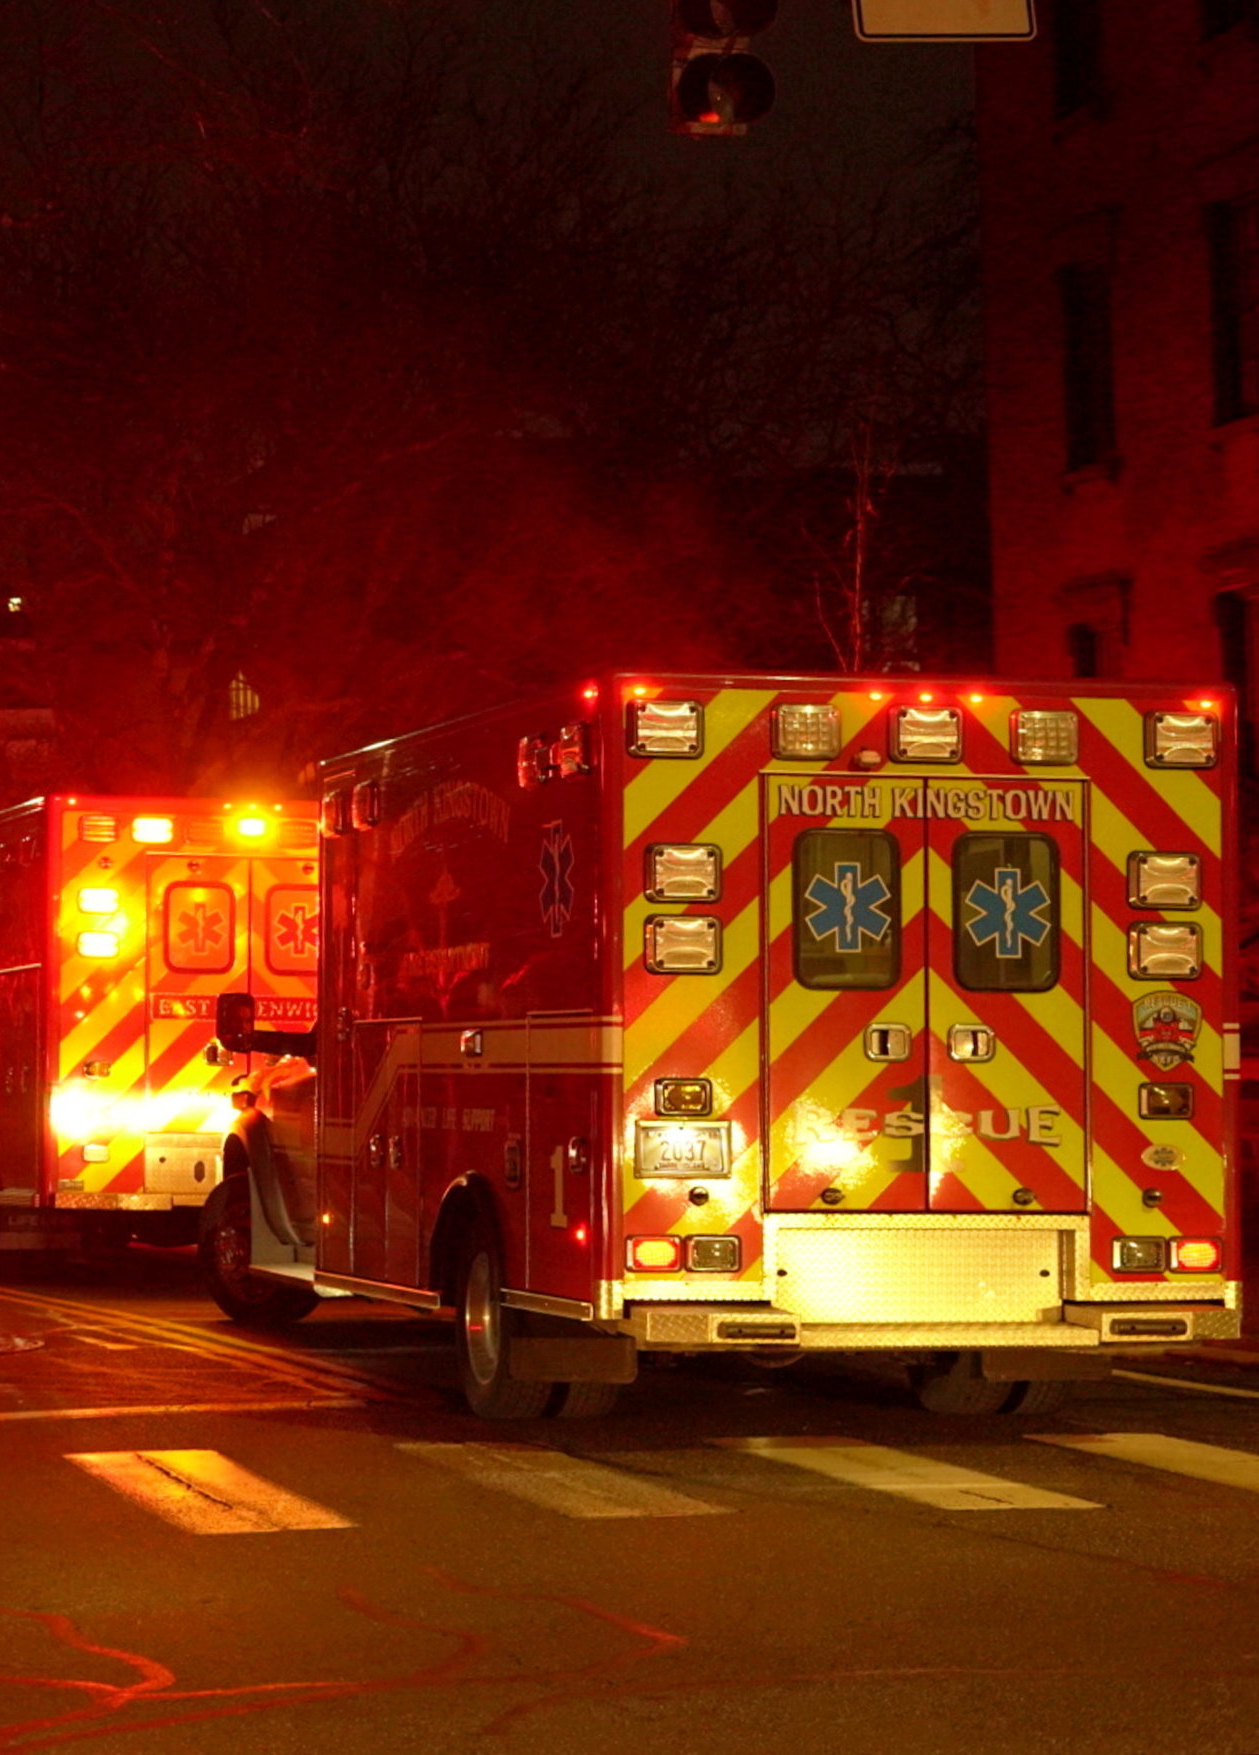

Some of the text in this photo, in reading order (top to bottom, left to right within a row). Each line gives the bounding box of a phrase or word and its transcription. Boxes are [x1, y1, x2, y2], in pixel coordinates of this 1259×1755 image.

[779, 784, 1075, 821] NORTH KINGSTOWN
[793, 1104, 1061, 1147] RESCUE
[661, 1141, 705, 1160] 2037
[550, 1145, 568, 1228] 1
